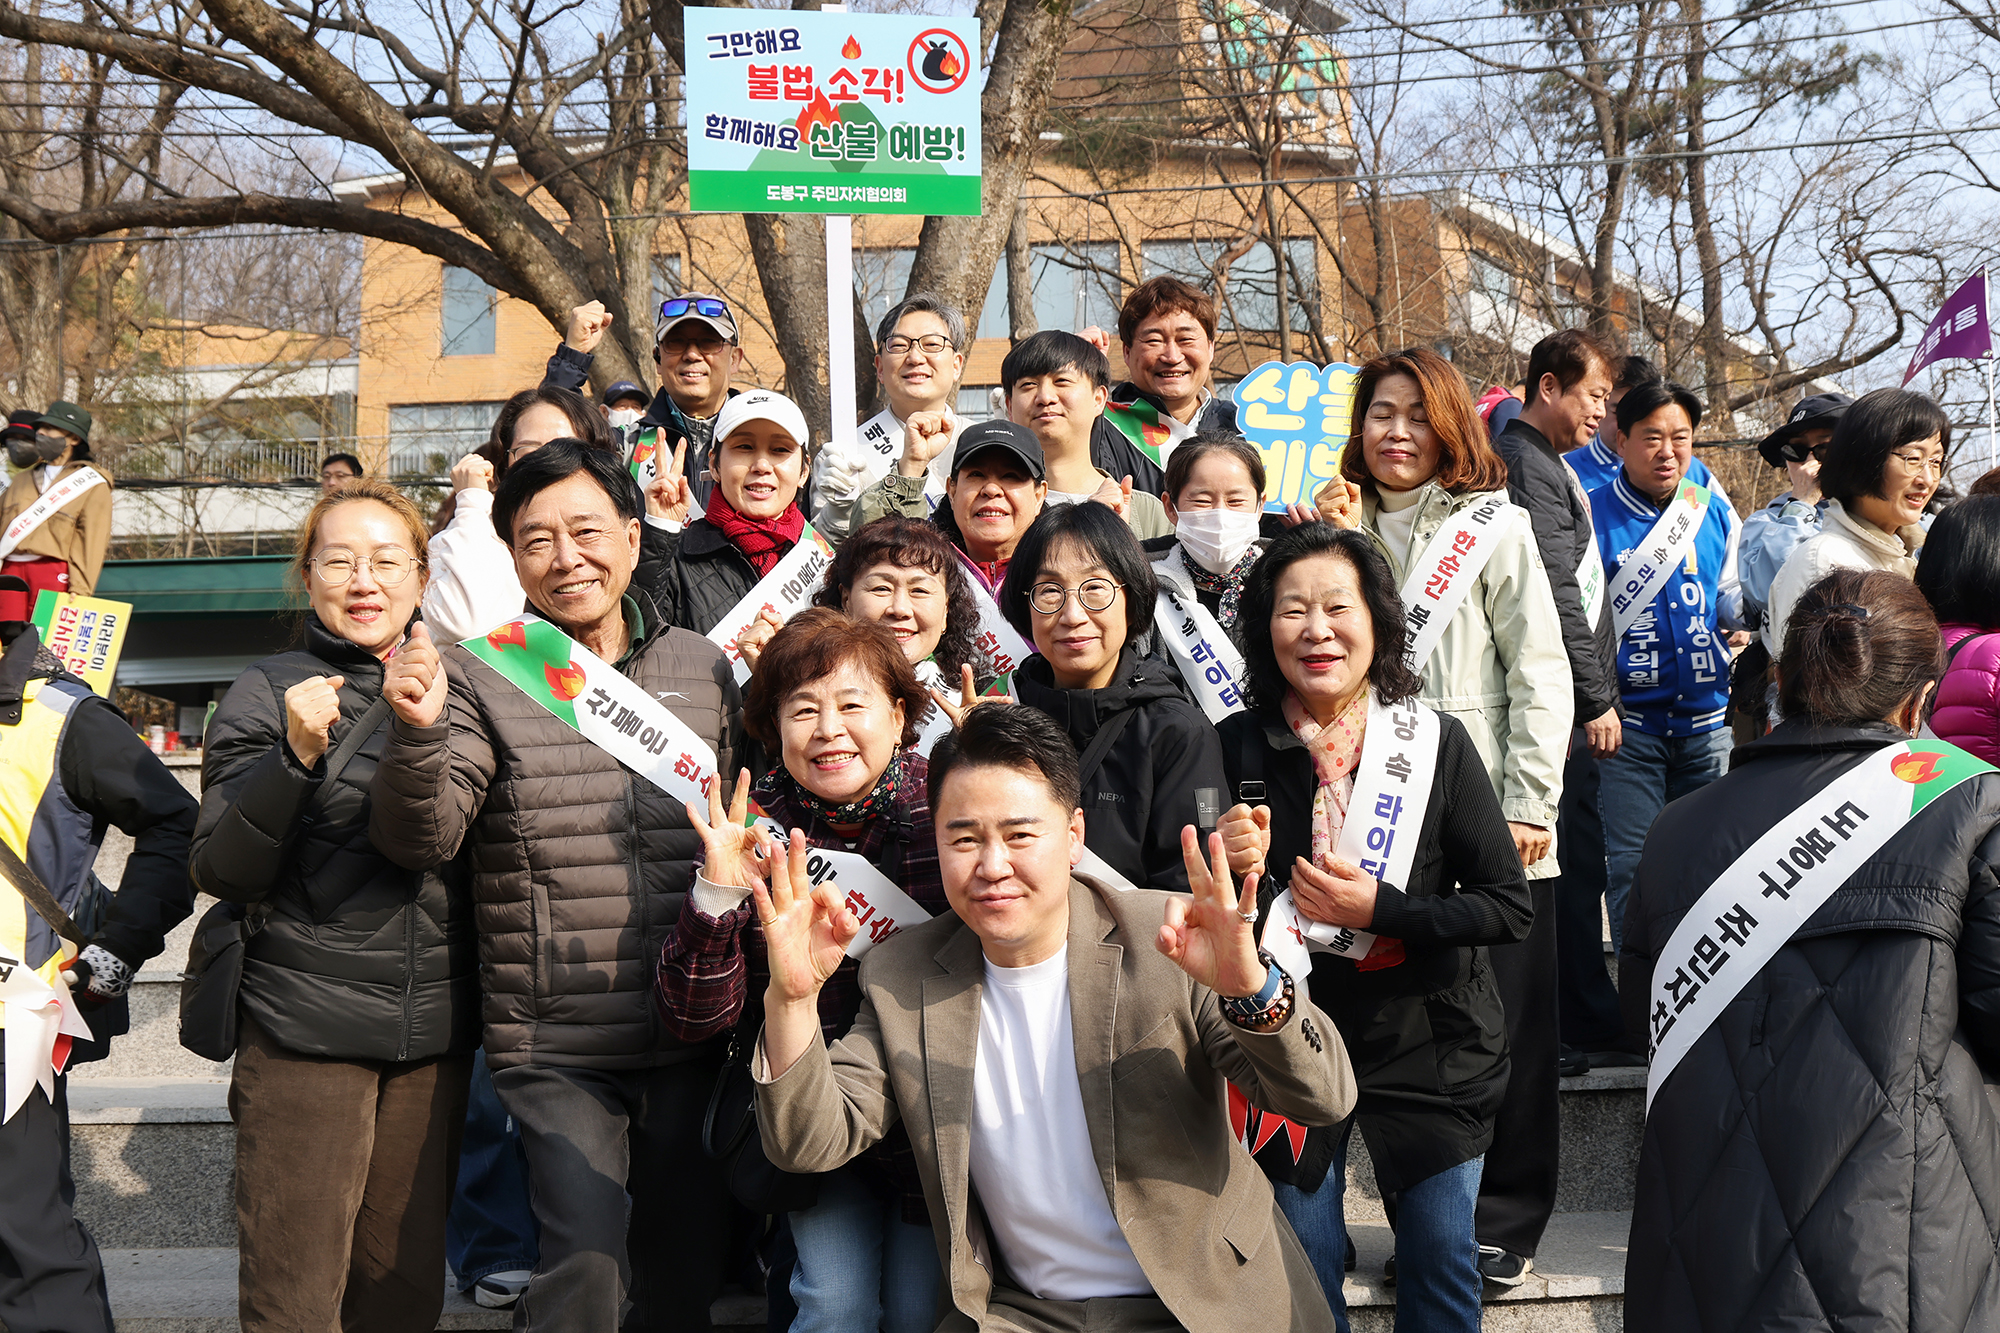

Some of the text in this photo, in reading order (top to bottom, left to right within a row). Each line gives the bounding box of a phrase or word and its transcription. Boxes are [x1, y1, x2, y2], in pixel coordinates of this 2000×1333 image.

[706, 27, 802, 59] 그만해요
[747, 63, 904, 104] 불법 소각!
[704, 113, 966, 161] 함께해요 산불 예방!
[766, 185, 907, 203] 도봉구 주민자치협의회
[863, 422, 894, 456] 배낭
[1667, 512, 1691, 547] 배낭
[779, 549, 826, 605] 산불은
[1424, 529, 1478, 601] 한순간
[1652, 546, 1670, 566] 속
[1612, 562, 1657, 616] 라이터
[73, 610, 97, 654] 도봉산
[90, 614, 117, 672] 여러분이
[1626, 602, 1661, 688] 봉구의원
[1679, 580, 1718, 684] 이성민
[1189, 638, 1243, 708] 라이터
[585, 686, 669, 756] 산불은
[1384, 752, 1413, 784] 속
[1097, 791, 1126, 803] NEPA
[1650, 799, 1871, 1050] 도봉구 주민자치
